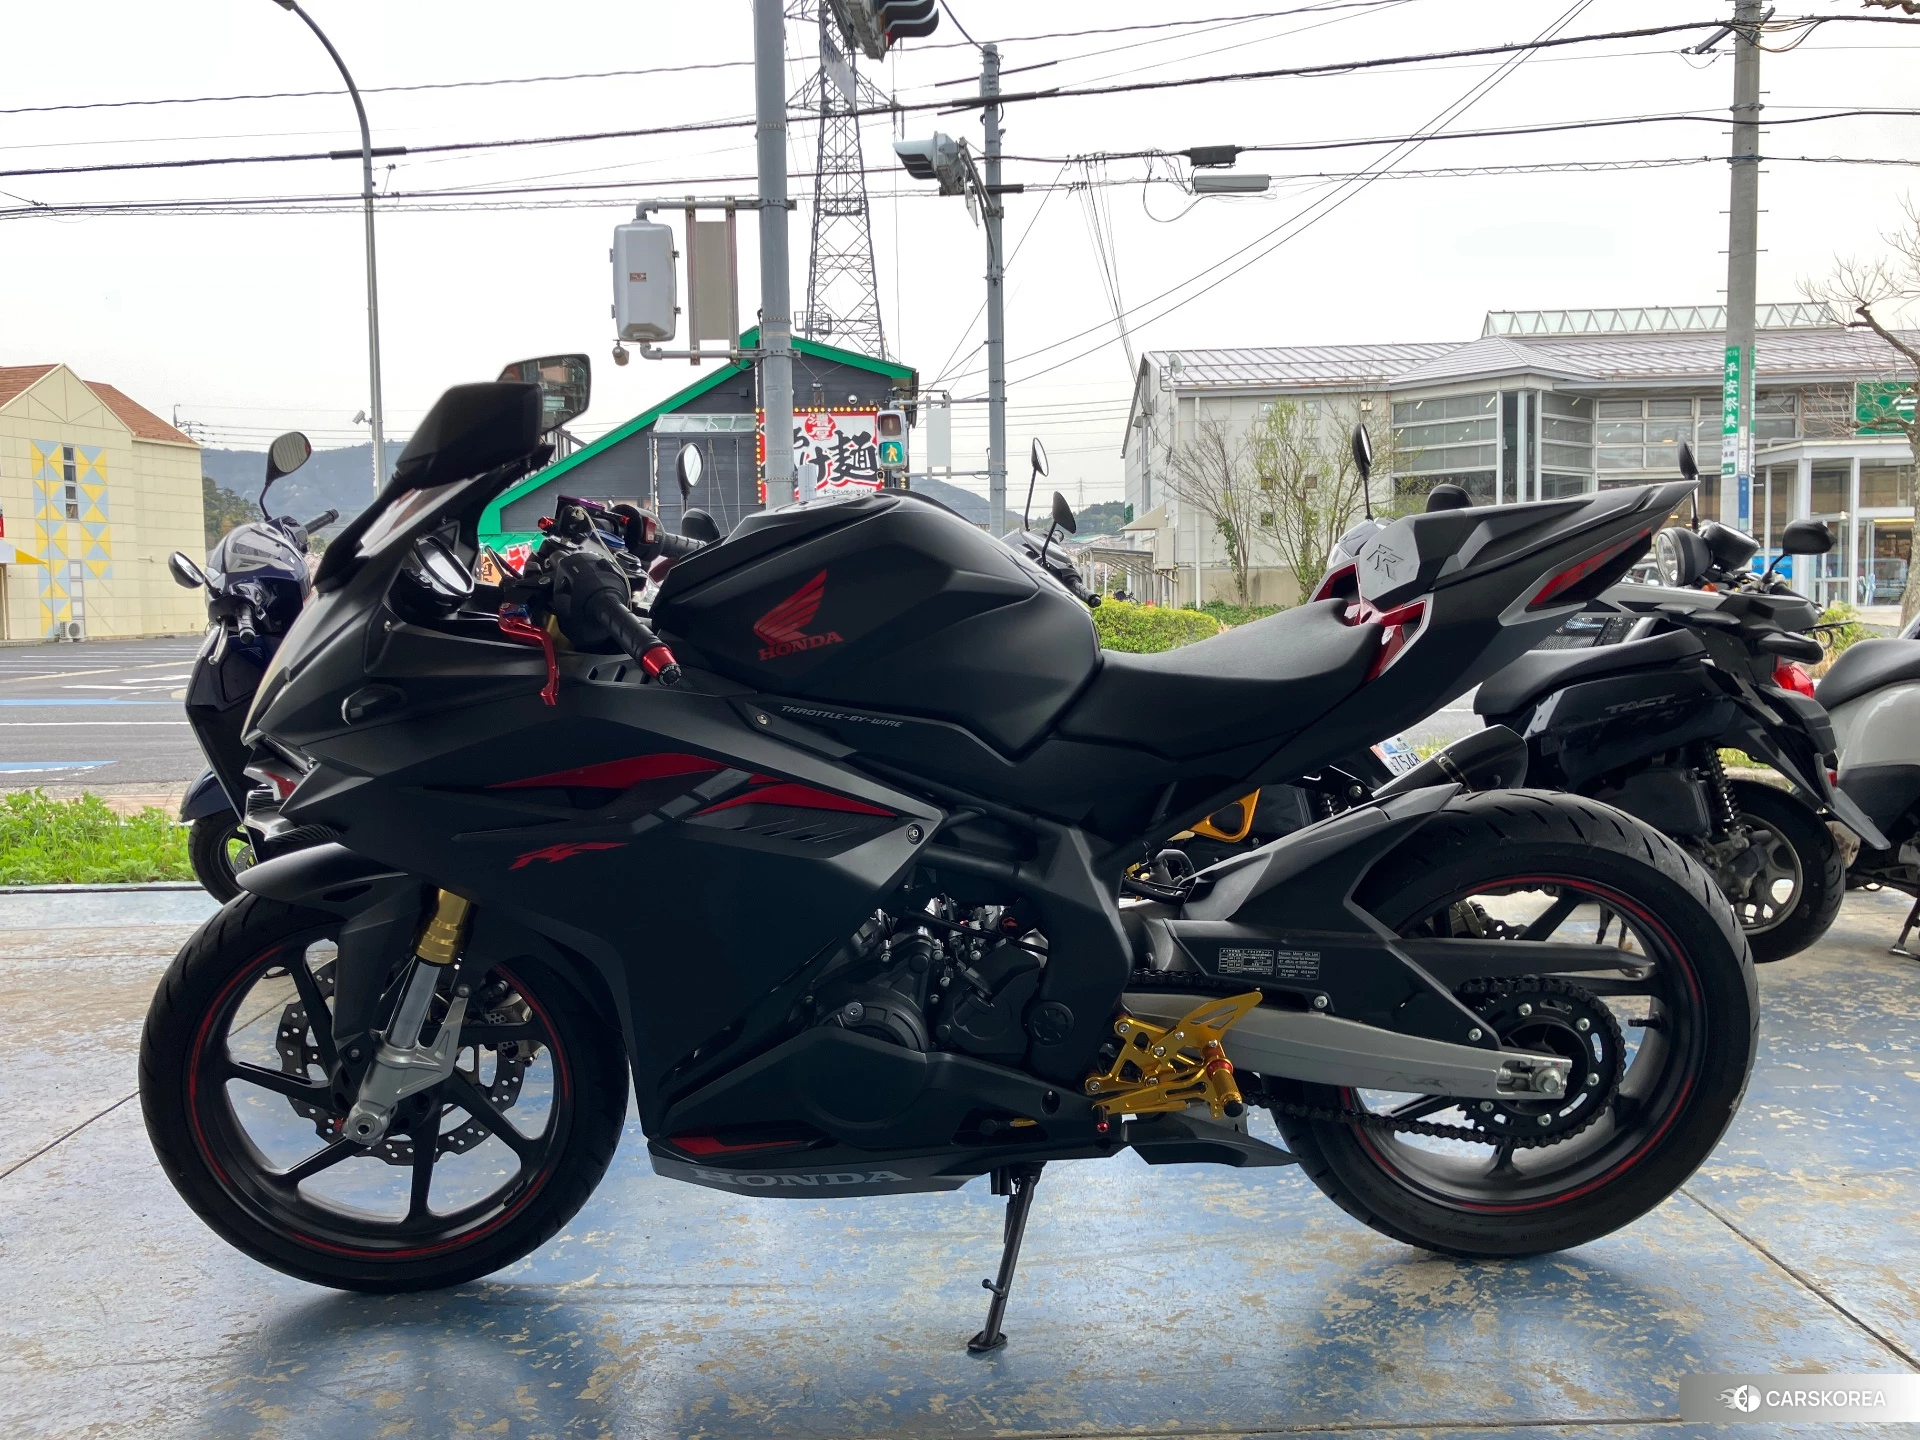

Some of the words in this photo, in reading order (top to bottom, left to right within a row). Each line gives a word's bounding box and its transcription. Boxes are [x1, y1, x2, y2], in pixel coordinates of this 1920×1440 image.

[758, 631, 844, 661] HONDA
[1605, 693, 1676, 714] TACT
[782, 705, 904, 728] THROTTLE-BY-WIRE
[689, 1167, 912, 1187] HONDA
